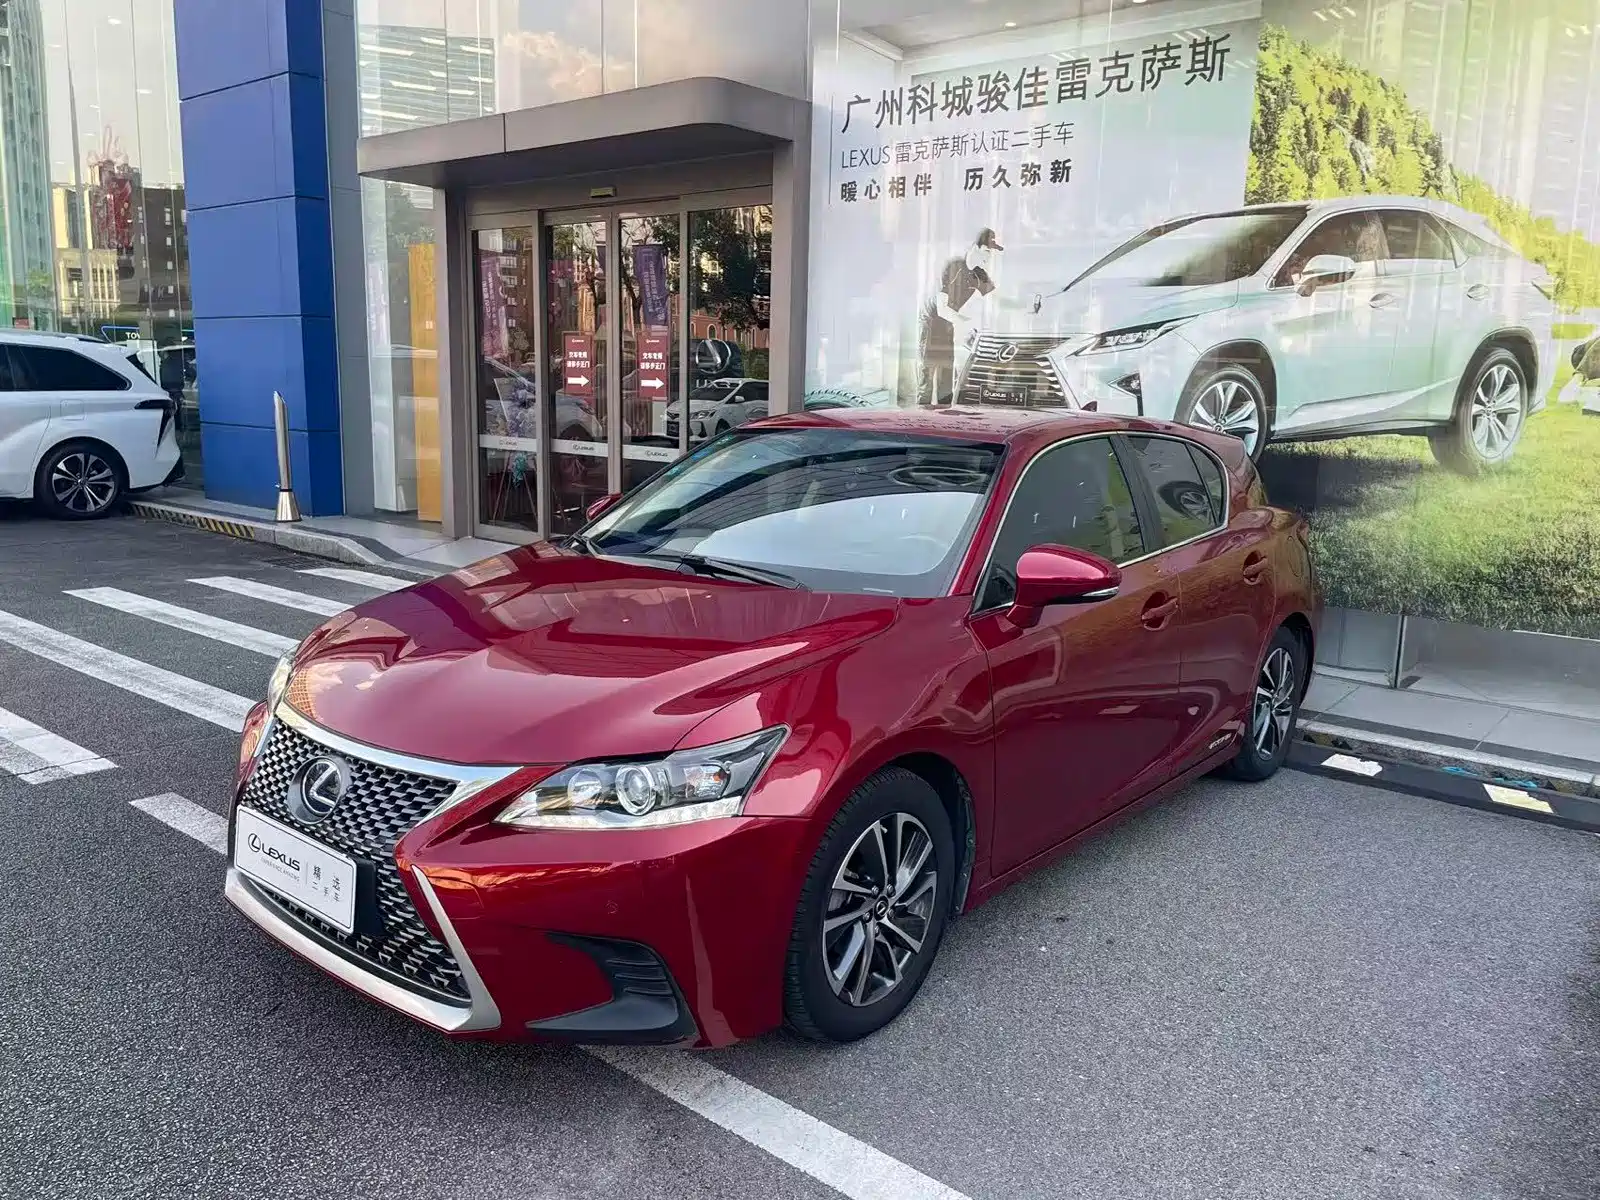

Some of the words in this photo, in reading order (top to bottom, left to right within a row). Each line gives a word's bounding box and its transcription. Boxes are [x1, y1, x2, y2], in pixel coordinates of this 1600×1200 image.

[841, 32, 1231, 134] 广州科城骏佳雷克萨斯
[841, 145, 891, 169] LEXUS
[895, 121, 1074, 164] 雷克萨斯认证二手车
[840, 173, 932, 202] 暖心相伴
[963, 158, 1072, 191] 历久弥新
[261, 842, 301, 872] LEXUS
